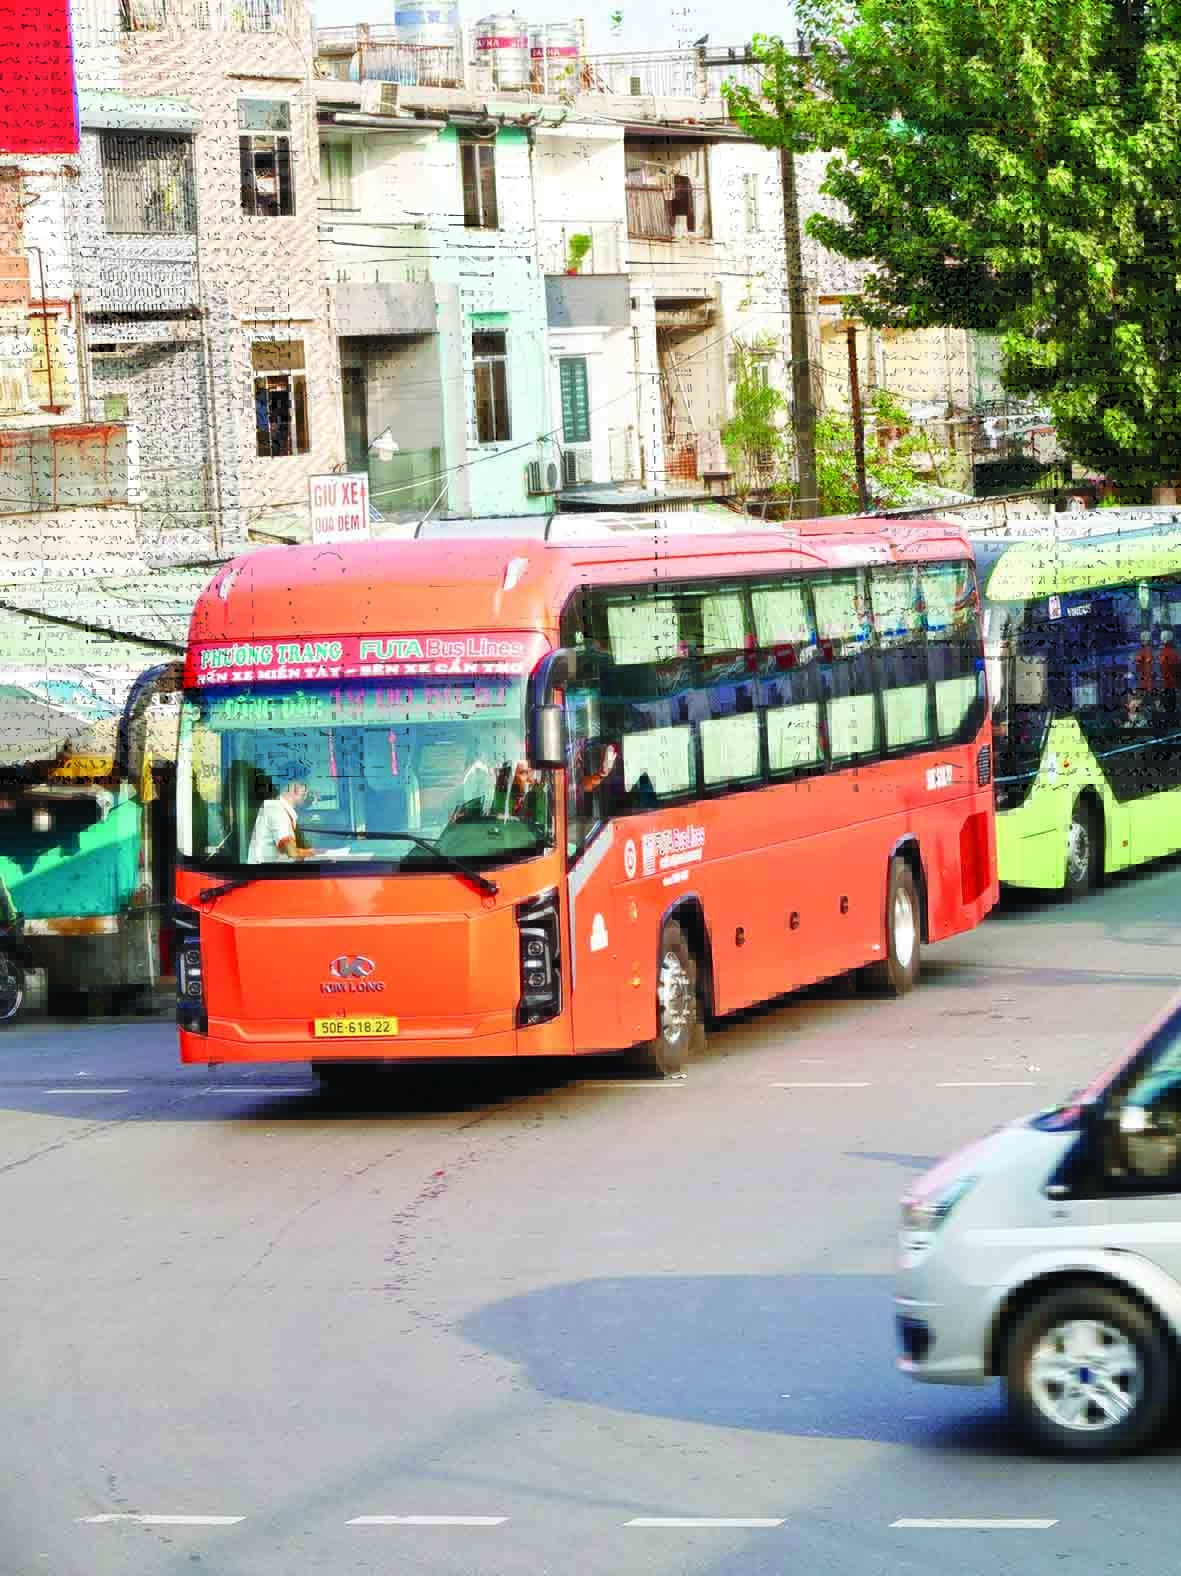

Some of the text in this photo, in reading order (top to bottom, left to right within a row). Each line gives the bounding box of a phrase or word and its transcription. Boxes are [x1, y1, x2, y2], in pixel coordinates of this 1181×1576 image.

[342, 481, 359, 505] XE
[277, 641, 344, 664] TRANG
[359, 638, 424, 660] FUTA
[232, 671, 254, 681] XE
[404, 663, 432, 674] XE
[320, 981, 385, 993] KIM LONG
